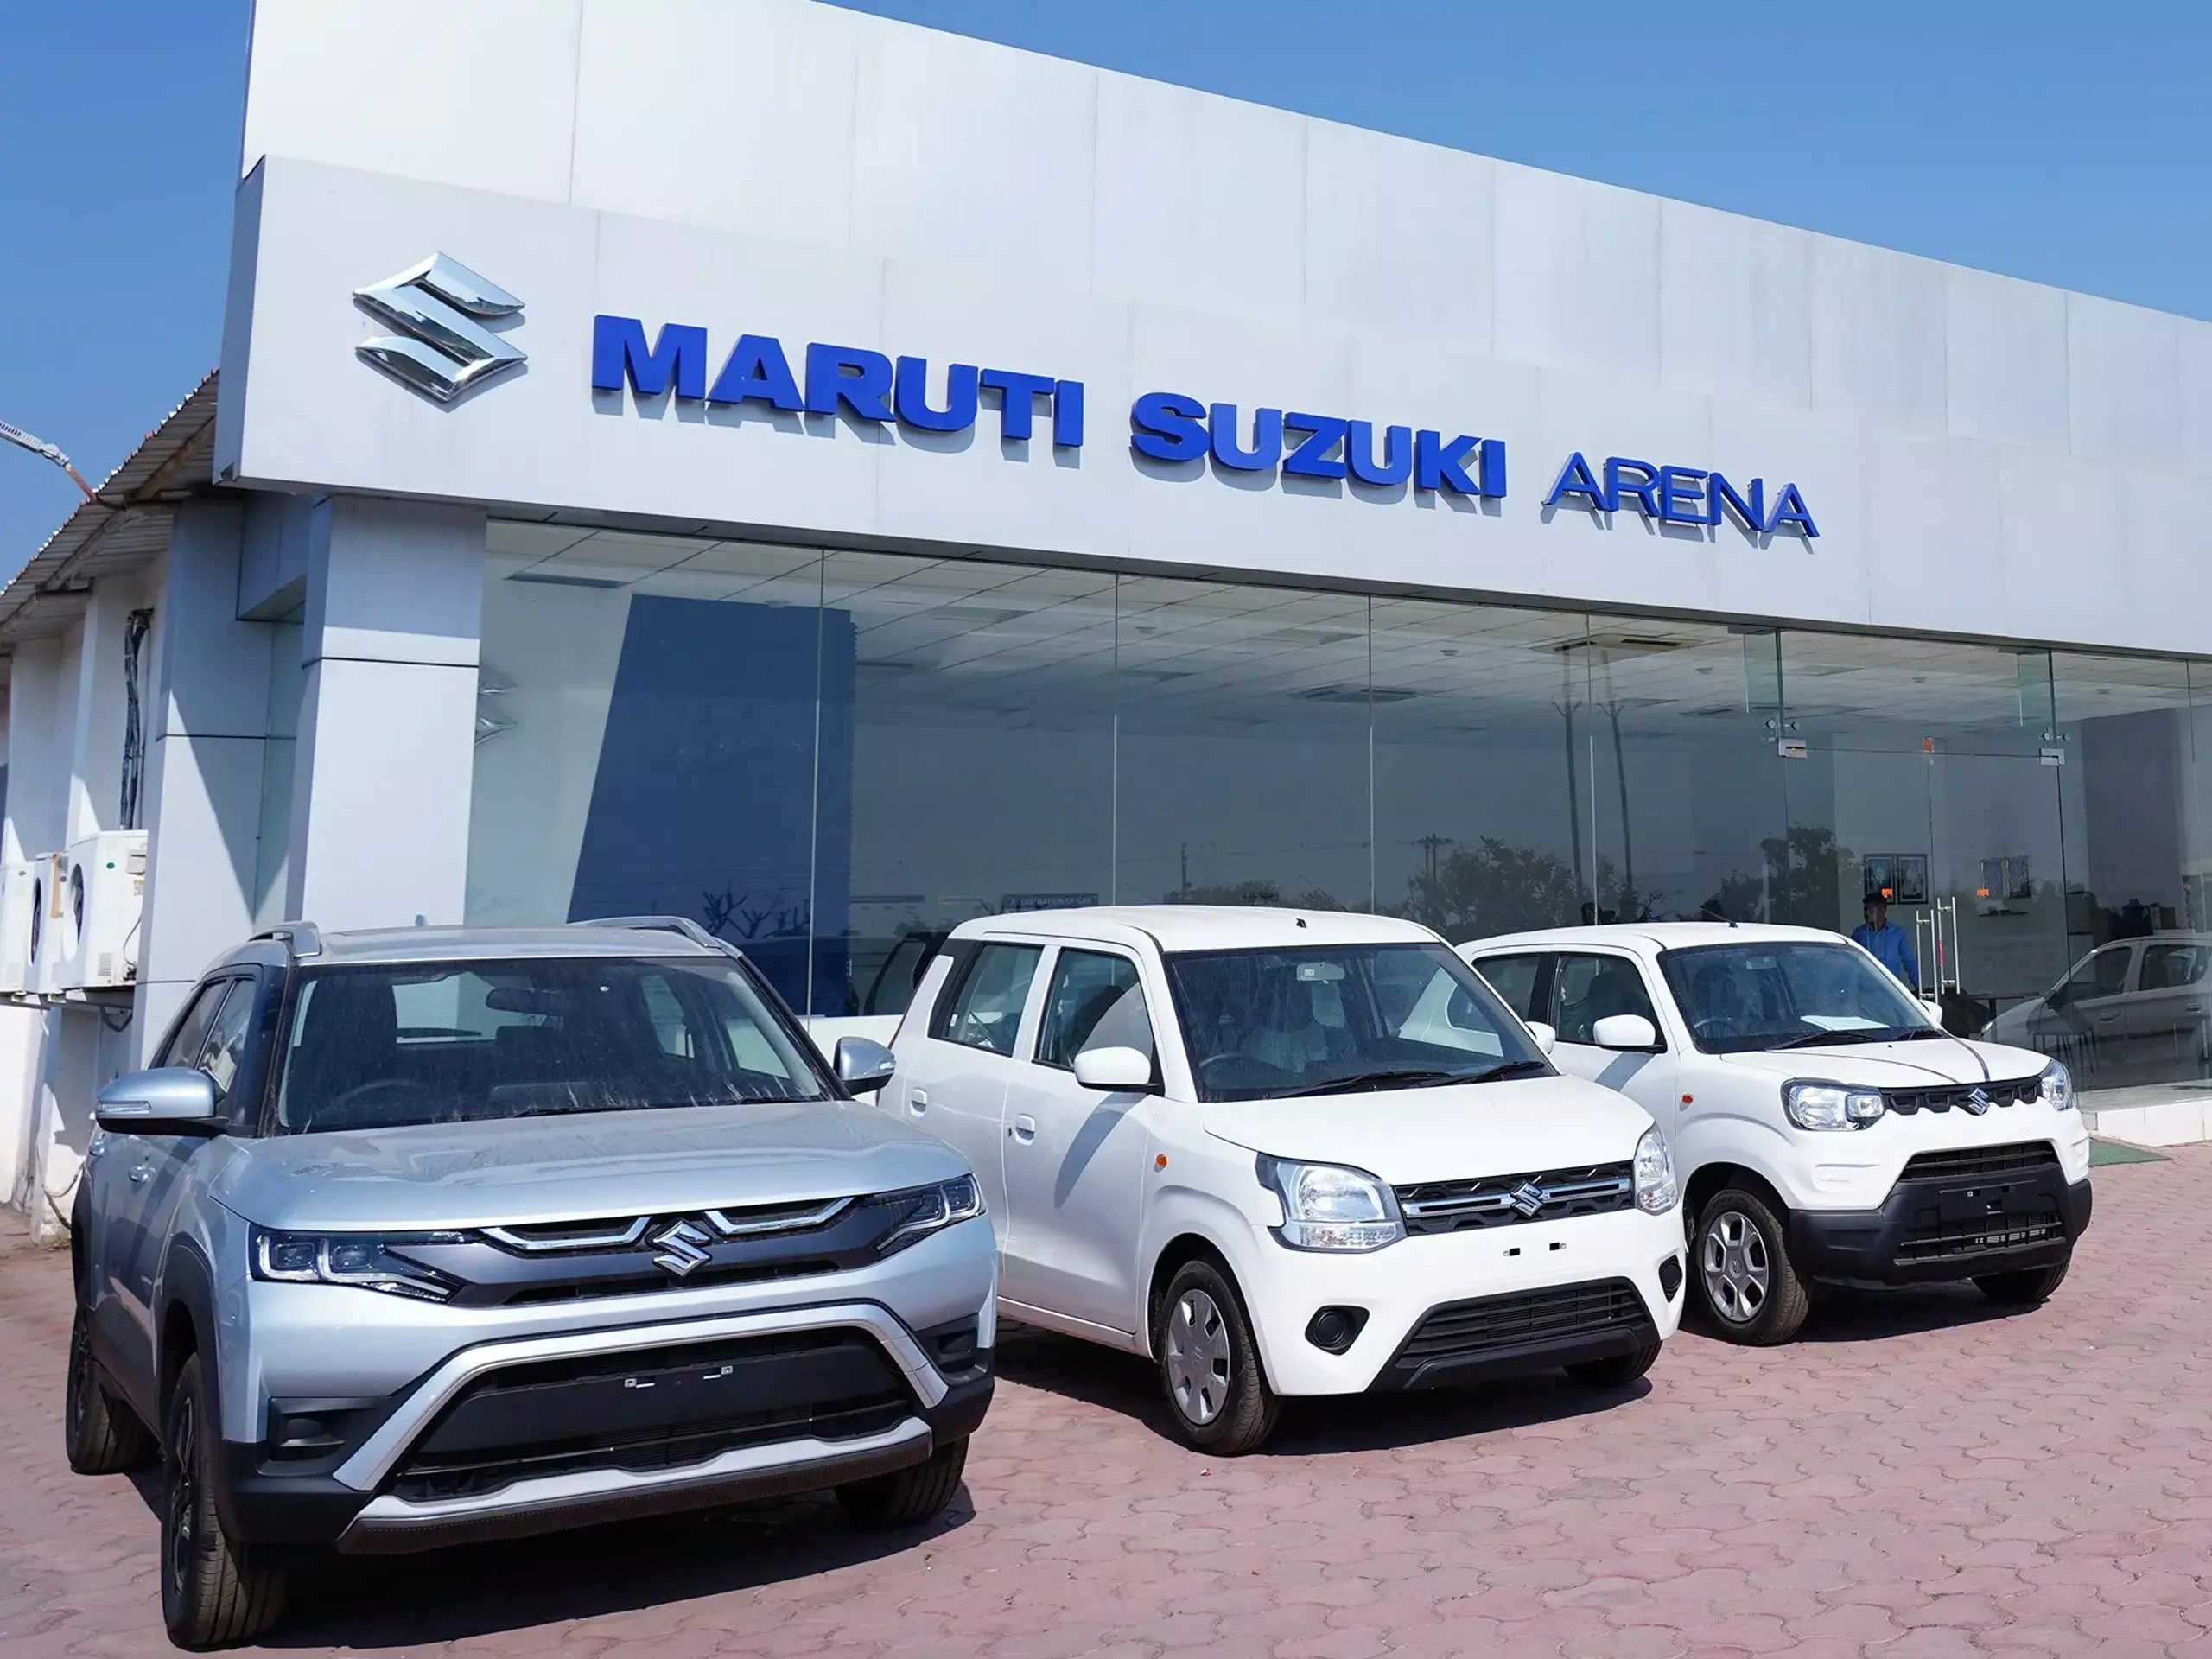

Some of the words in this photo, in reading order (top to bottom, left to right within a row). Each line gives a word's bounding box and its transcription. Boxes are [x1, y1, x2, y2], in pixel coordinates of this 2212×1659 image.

[591, 314, 1085, 448] MARUTI
[1130, 391, 1507, 499] SUZUKI
[1543, 451, 1821, 538] ARENA
